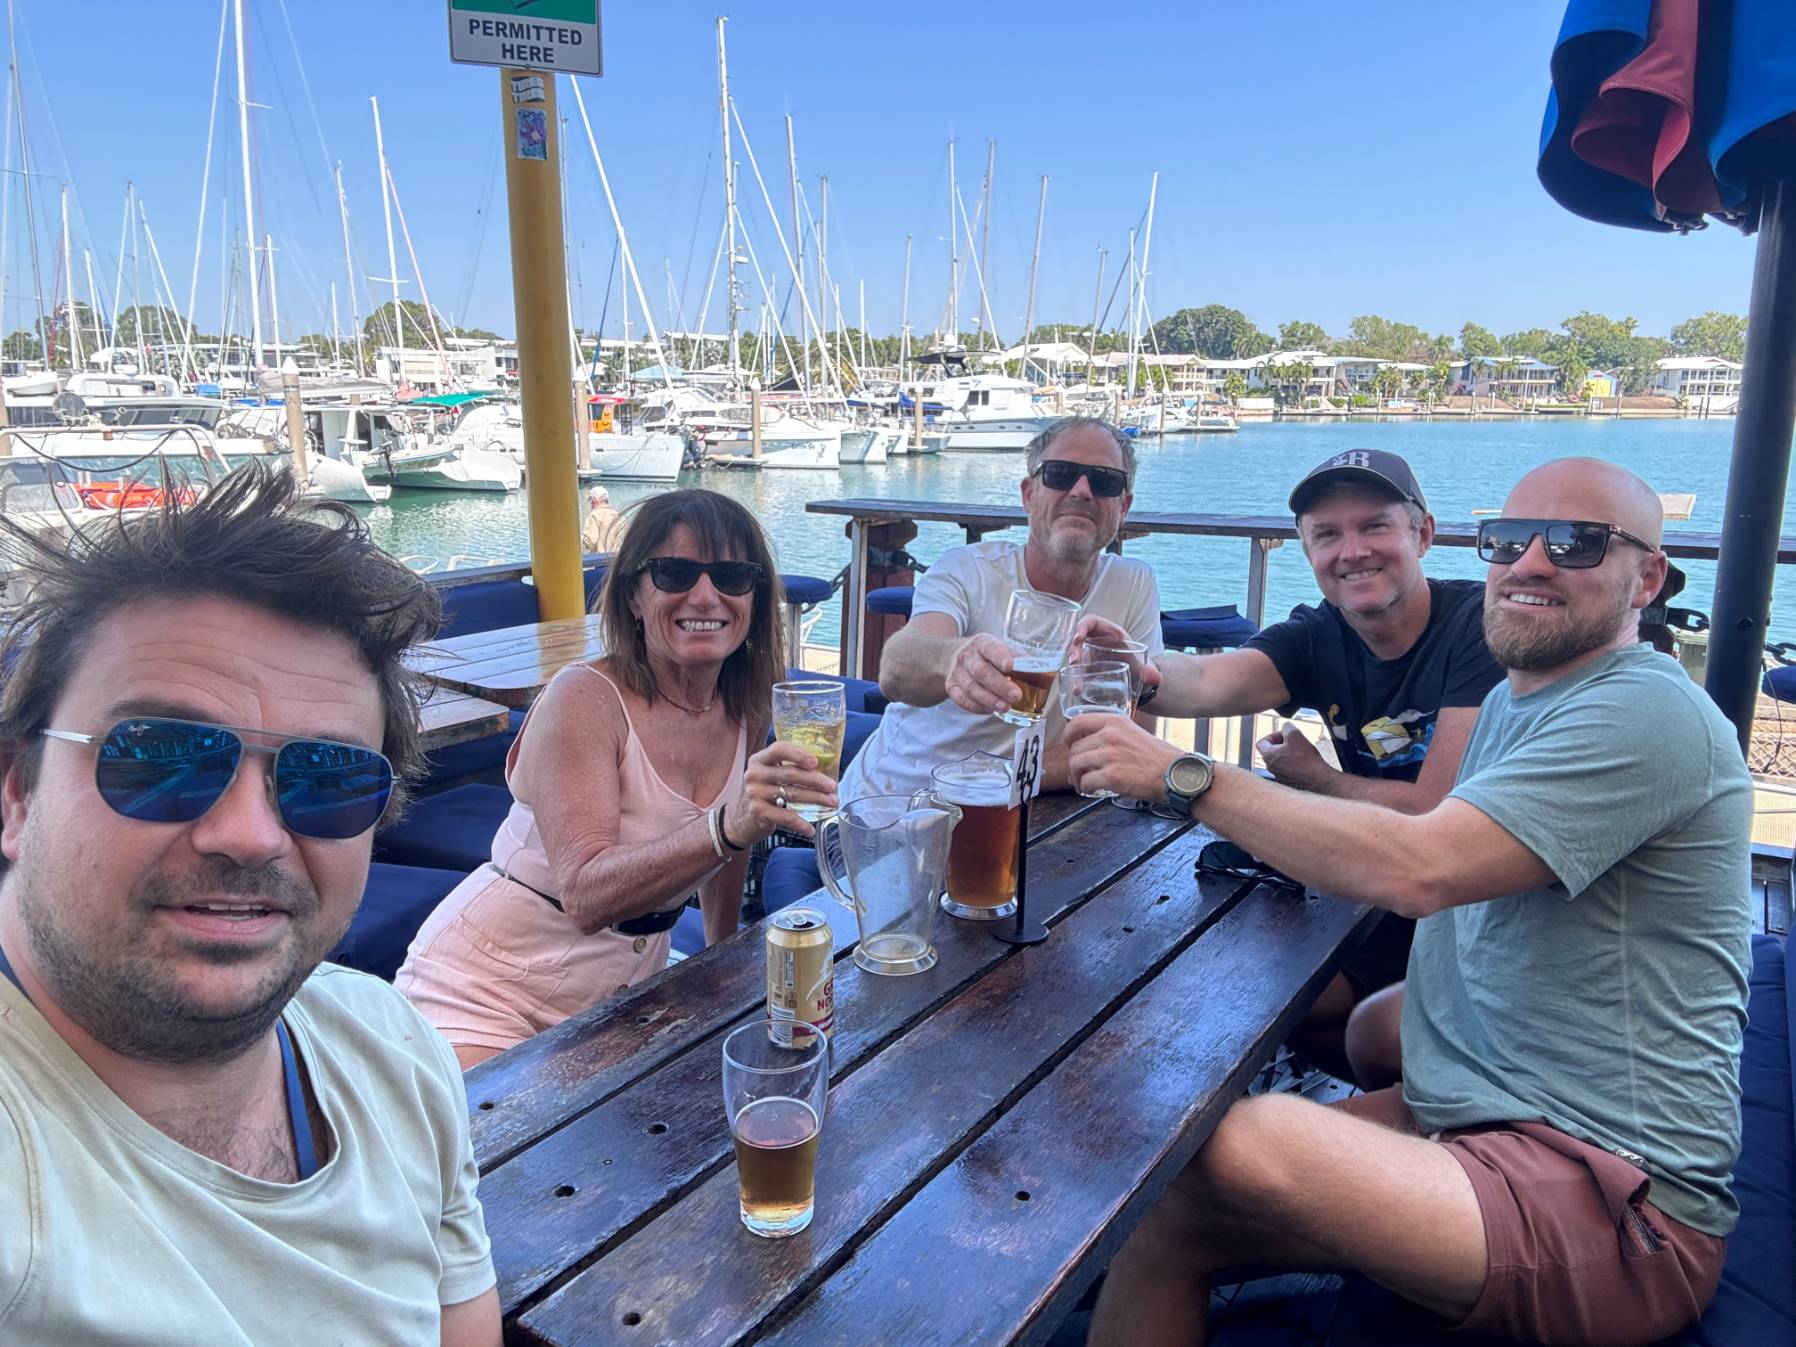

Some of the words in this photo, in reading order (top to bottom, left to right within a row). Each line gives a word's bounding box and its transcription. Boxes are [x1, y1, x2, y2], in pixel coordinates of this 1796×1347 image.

[468, 18, 583, 46] PERMITTED
[501, 43, 555, 64] HERE
[1016, 734, 1040, 786] 43
